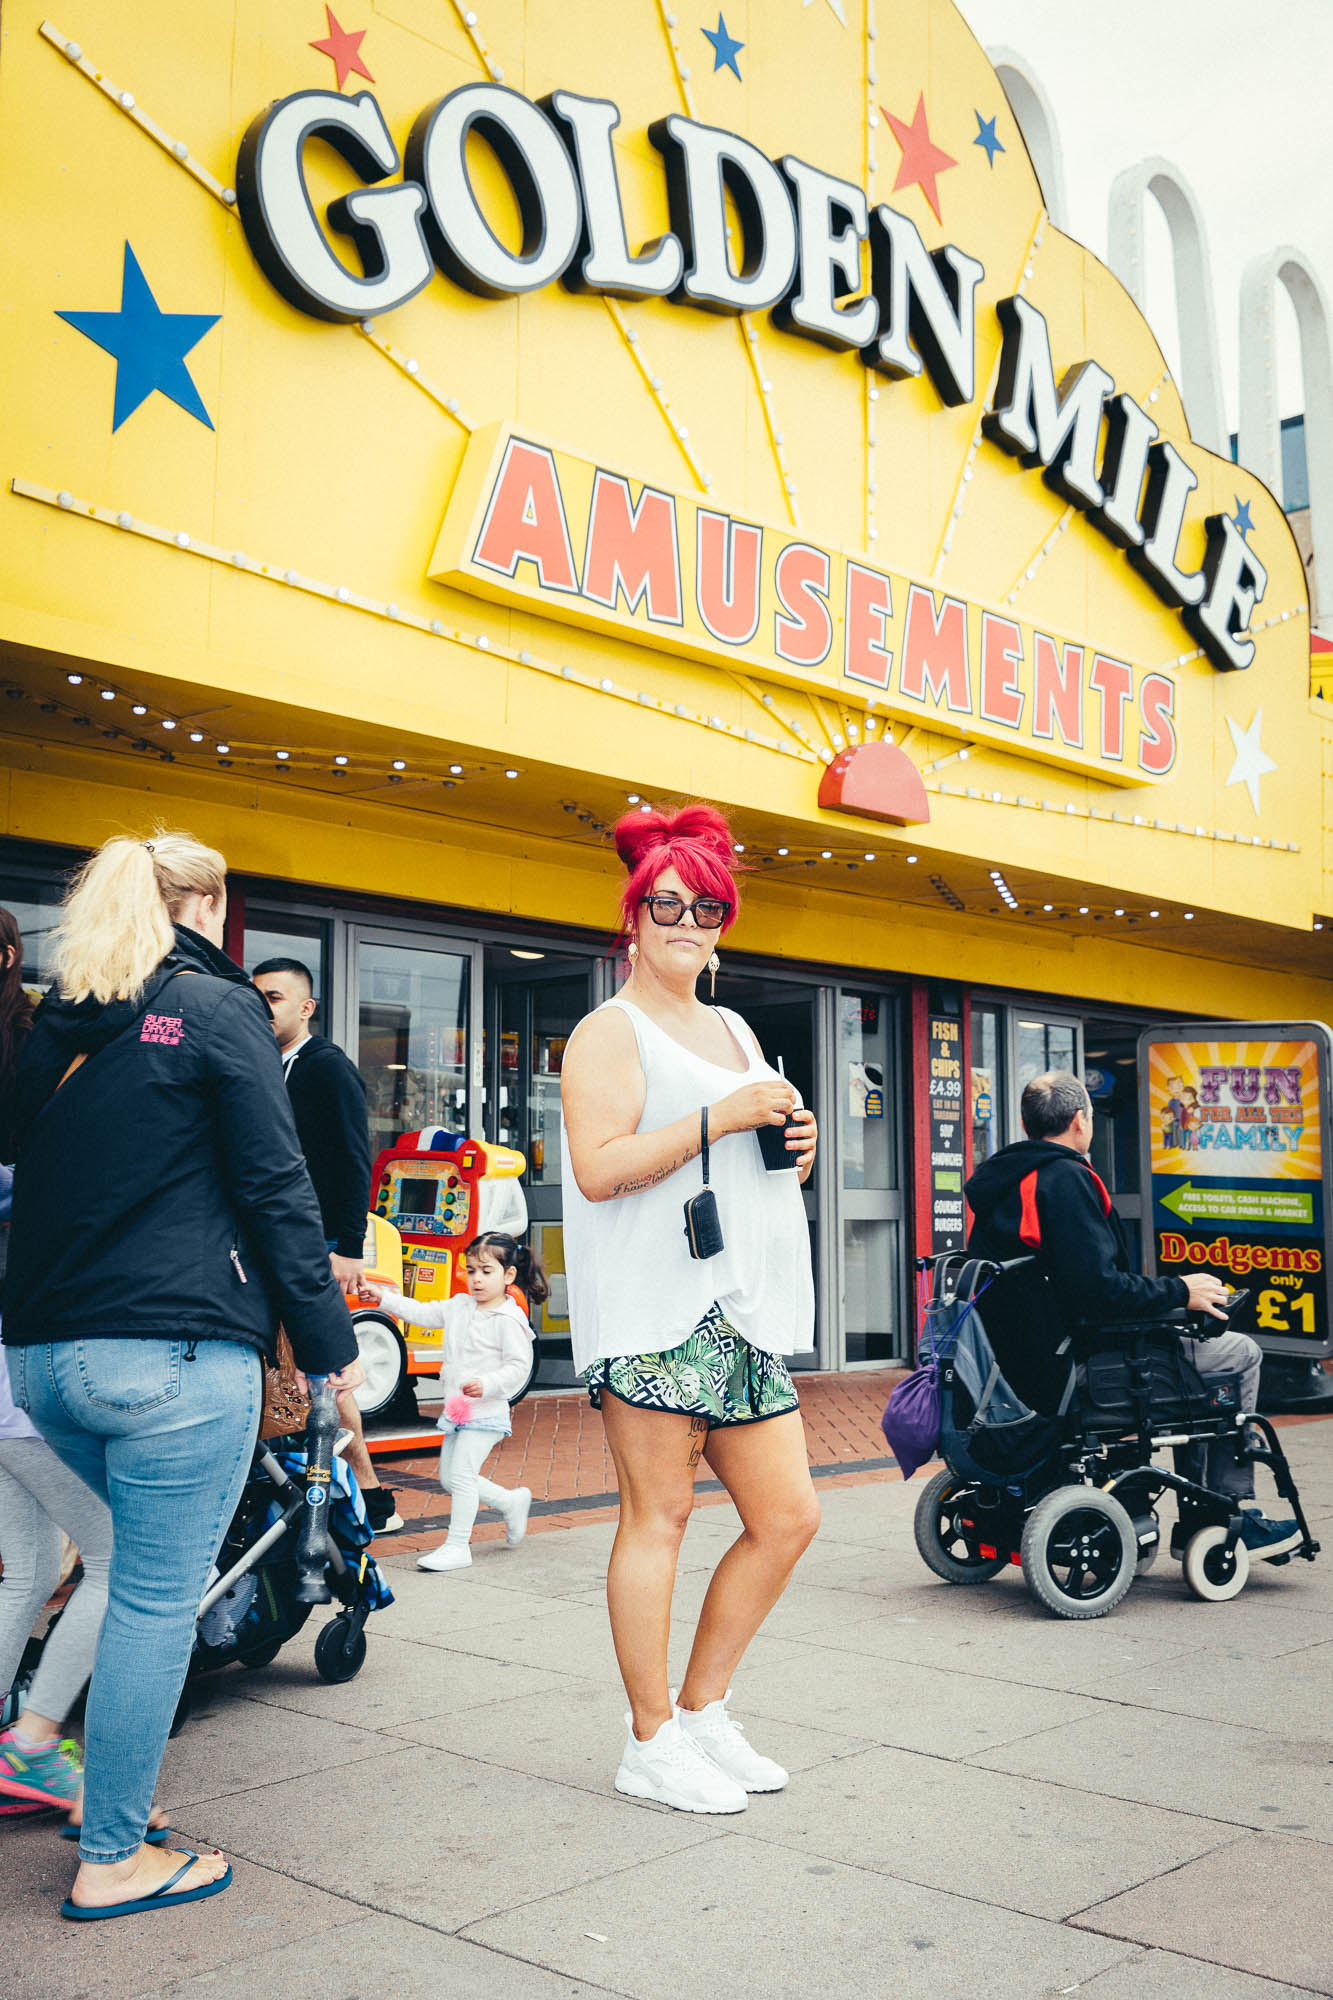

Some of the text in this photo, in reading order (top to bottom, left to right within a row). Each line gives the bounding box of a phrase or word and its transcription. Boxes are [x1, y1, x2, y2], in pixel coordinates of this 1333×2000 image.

[236, 82, 1268, 672] GOLDEN MILE
[472, 435, 1176, 775] AMUSEMENTS
[145, 1014, 183, 1027] SUPER
[932, 1021, 958, 1040] FISH
[941, 1041, 950, 1057] &
[931, 1057, 960, 1078] CHIPS
[929, 1080, 961, 1097] £4.99
[1199, 1066, 1302, 1104] FUN
[1200, 1106, 1304, 1123] FOR ALL THE
[1199, 1123, 1304, 1152] FAMILY
[1237, 1195, 1258, 1204] CASH
[1178, 1203, 1206, 1213] ACCESS
[1208, 1205, 1220, 1214] TO
[1221, 1205, 1237, 1215] CAR
[1238, 1206, 1265, 1216] PARKS
[1274, 1208, 1309, 1218] MARKET
[1160, 1233, 1321, 1274] Dodgems
[1270, 1274, 1304, 1290] only
[1256, 1289, 1316, 1333] £1
